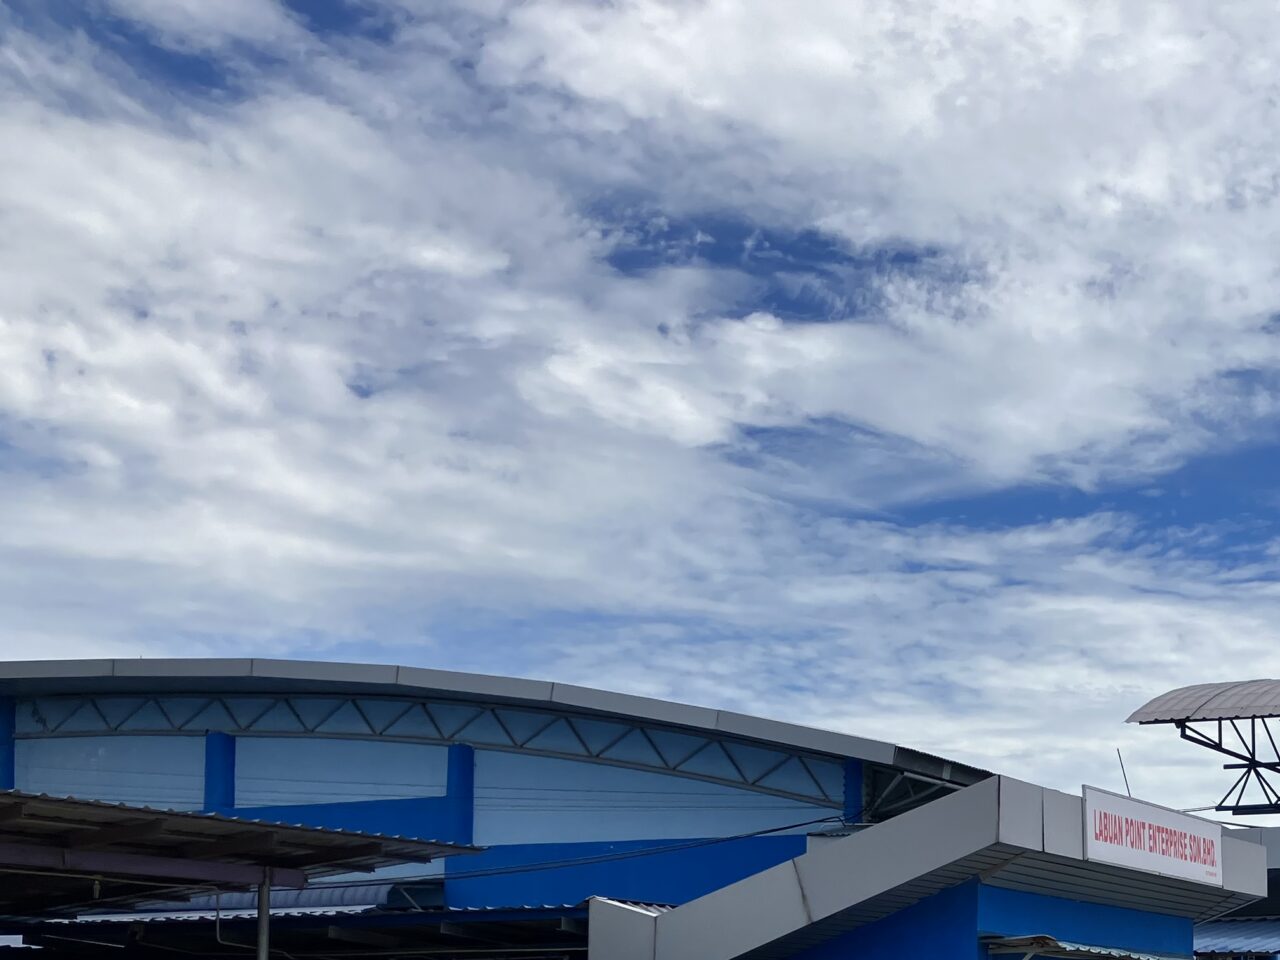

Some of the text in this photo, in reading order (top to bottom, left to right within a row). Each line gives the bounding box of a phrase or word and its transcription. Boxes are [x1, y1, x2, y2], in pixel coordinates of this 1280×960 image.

[1094, 809, 1123, 846] LABUAN
[1125, 818, 1146, 851] POINT
[1148, 824, 1187, 861] ENTERPRISE
